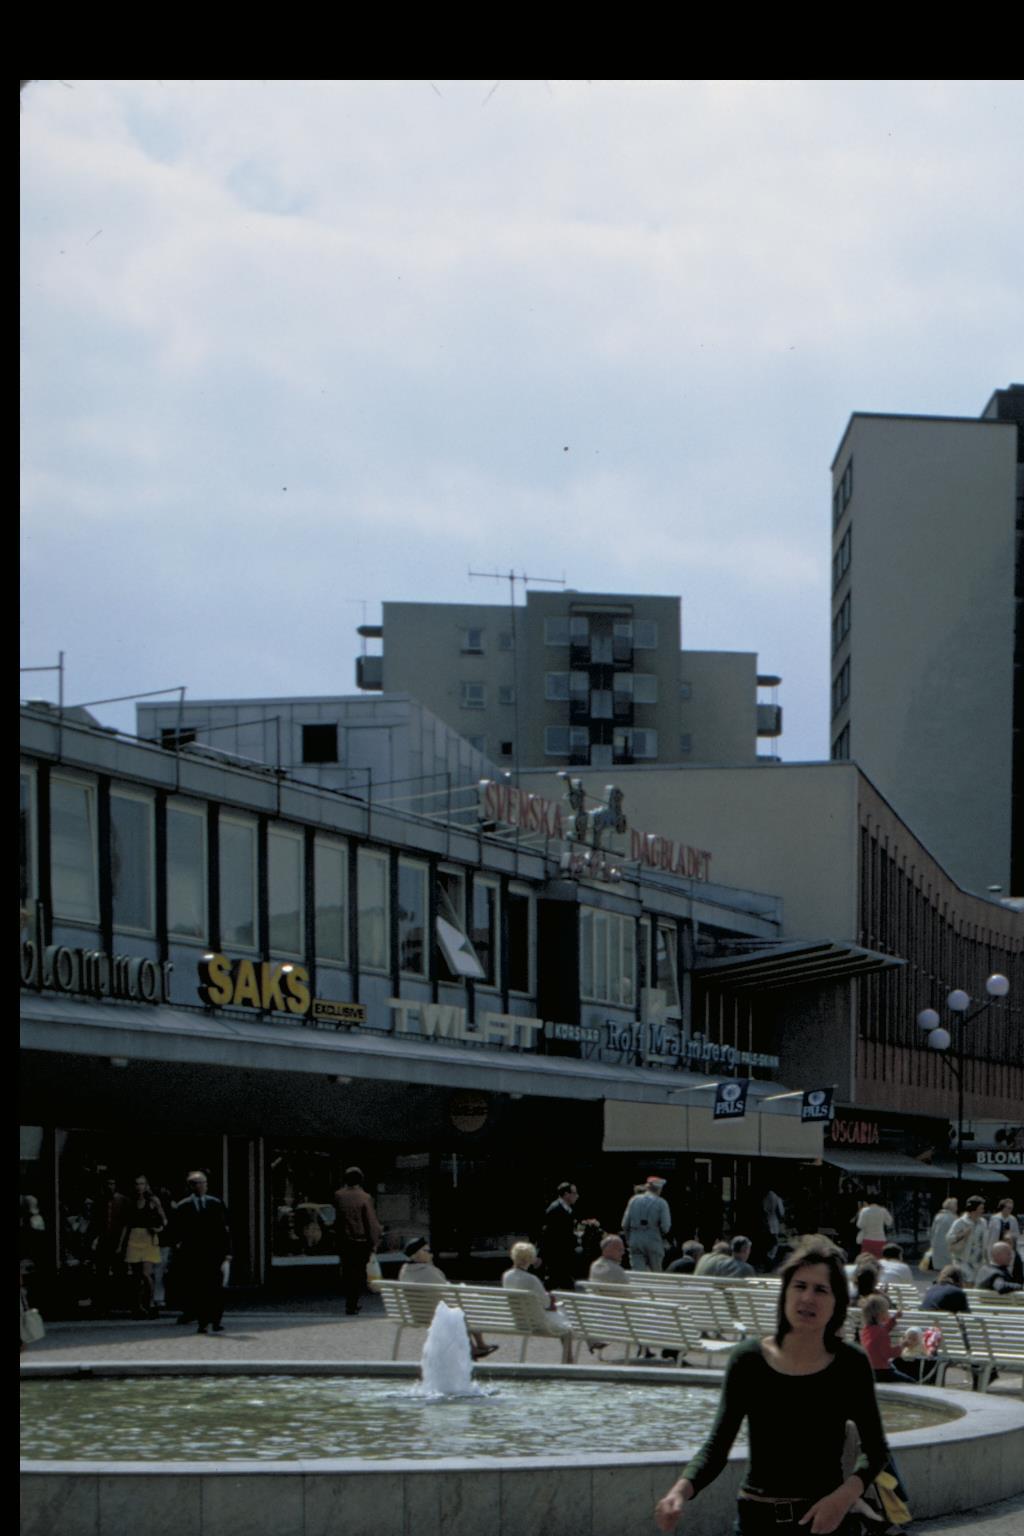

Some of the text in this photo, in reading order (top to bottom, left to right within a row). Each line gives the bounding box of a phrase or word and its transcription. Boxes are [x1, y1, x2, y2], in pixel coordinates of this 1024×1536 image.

[204, 953, 312, 1015] SAKS
[605, 1019, 645, 1052] Rolf
[831, 1119, 880, 1145] OSCARIA
